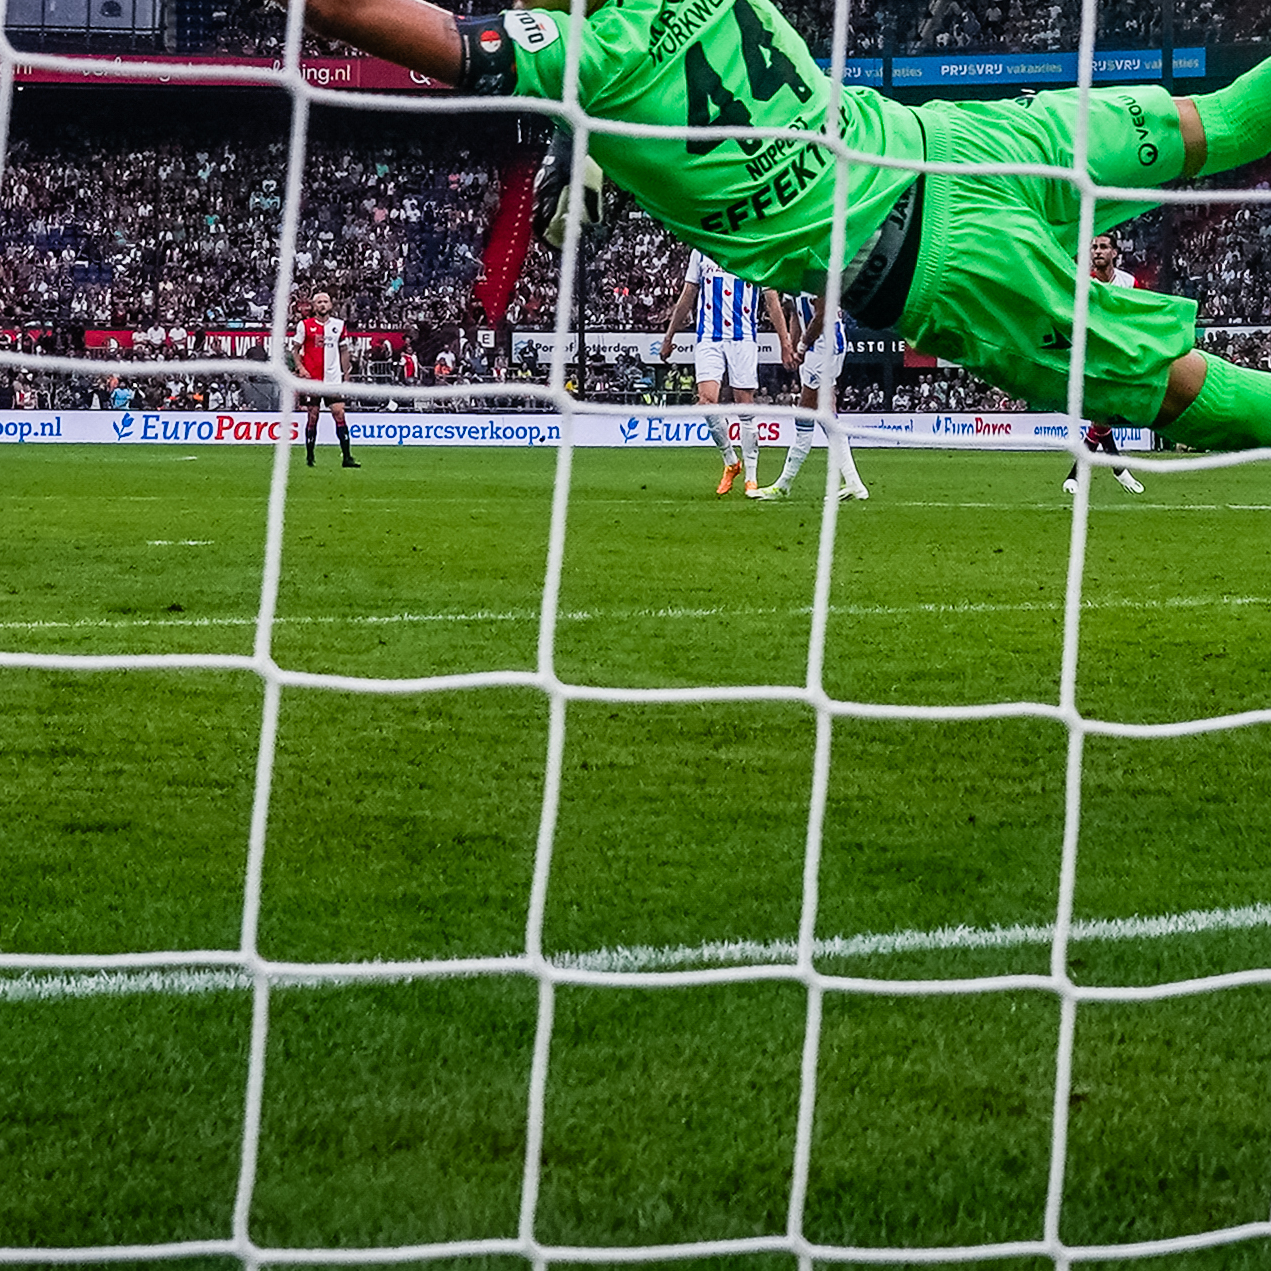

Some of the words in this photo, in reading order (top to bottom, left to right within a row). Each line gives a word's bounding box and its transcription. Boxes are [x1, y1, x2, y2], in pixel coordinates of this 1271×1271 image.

[516, 11, 545, 44] TOTO
[1006, 62, 1063, 75] vakanties
[481, 333, 491, 344] E
[536, 343, 555, 352] Por
[585, 342, 639, 352] otterdam
[671, 343, 694, 353] Port
[846, 340, 906, 353] ASTOE
[141, 413, 299, 441] EuroParcs
[349, 420, 561, 445] europarcsverkoop.n
[645, 417, 780, 442] Euroacs
